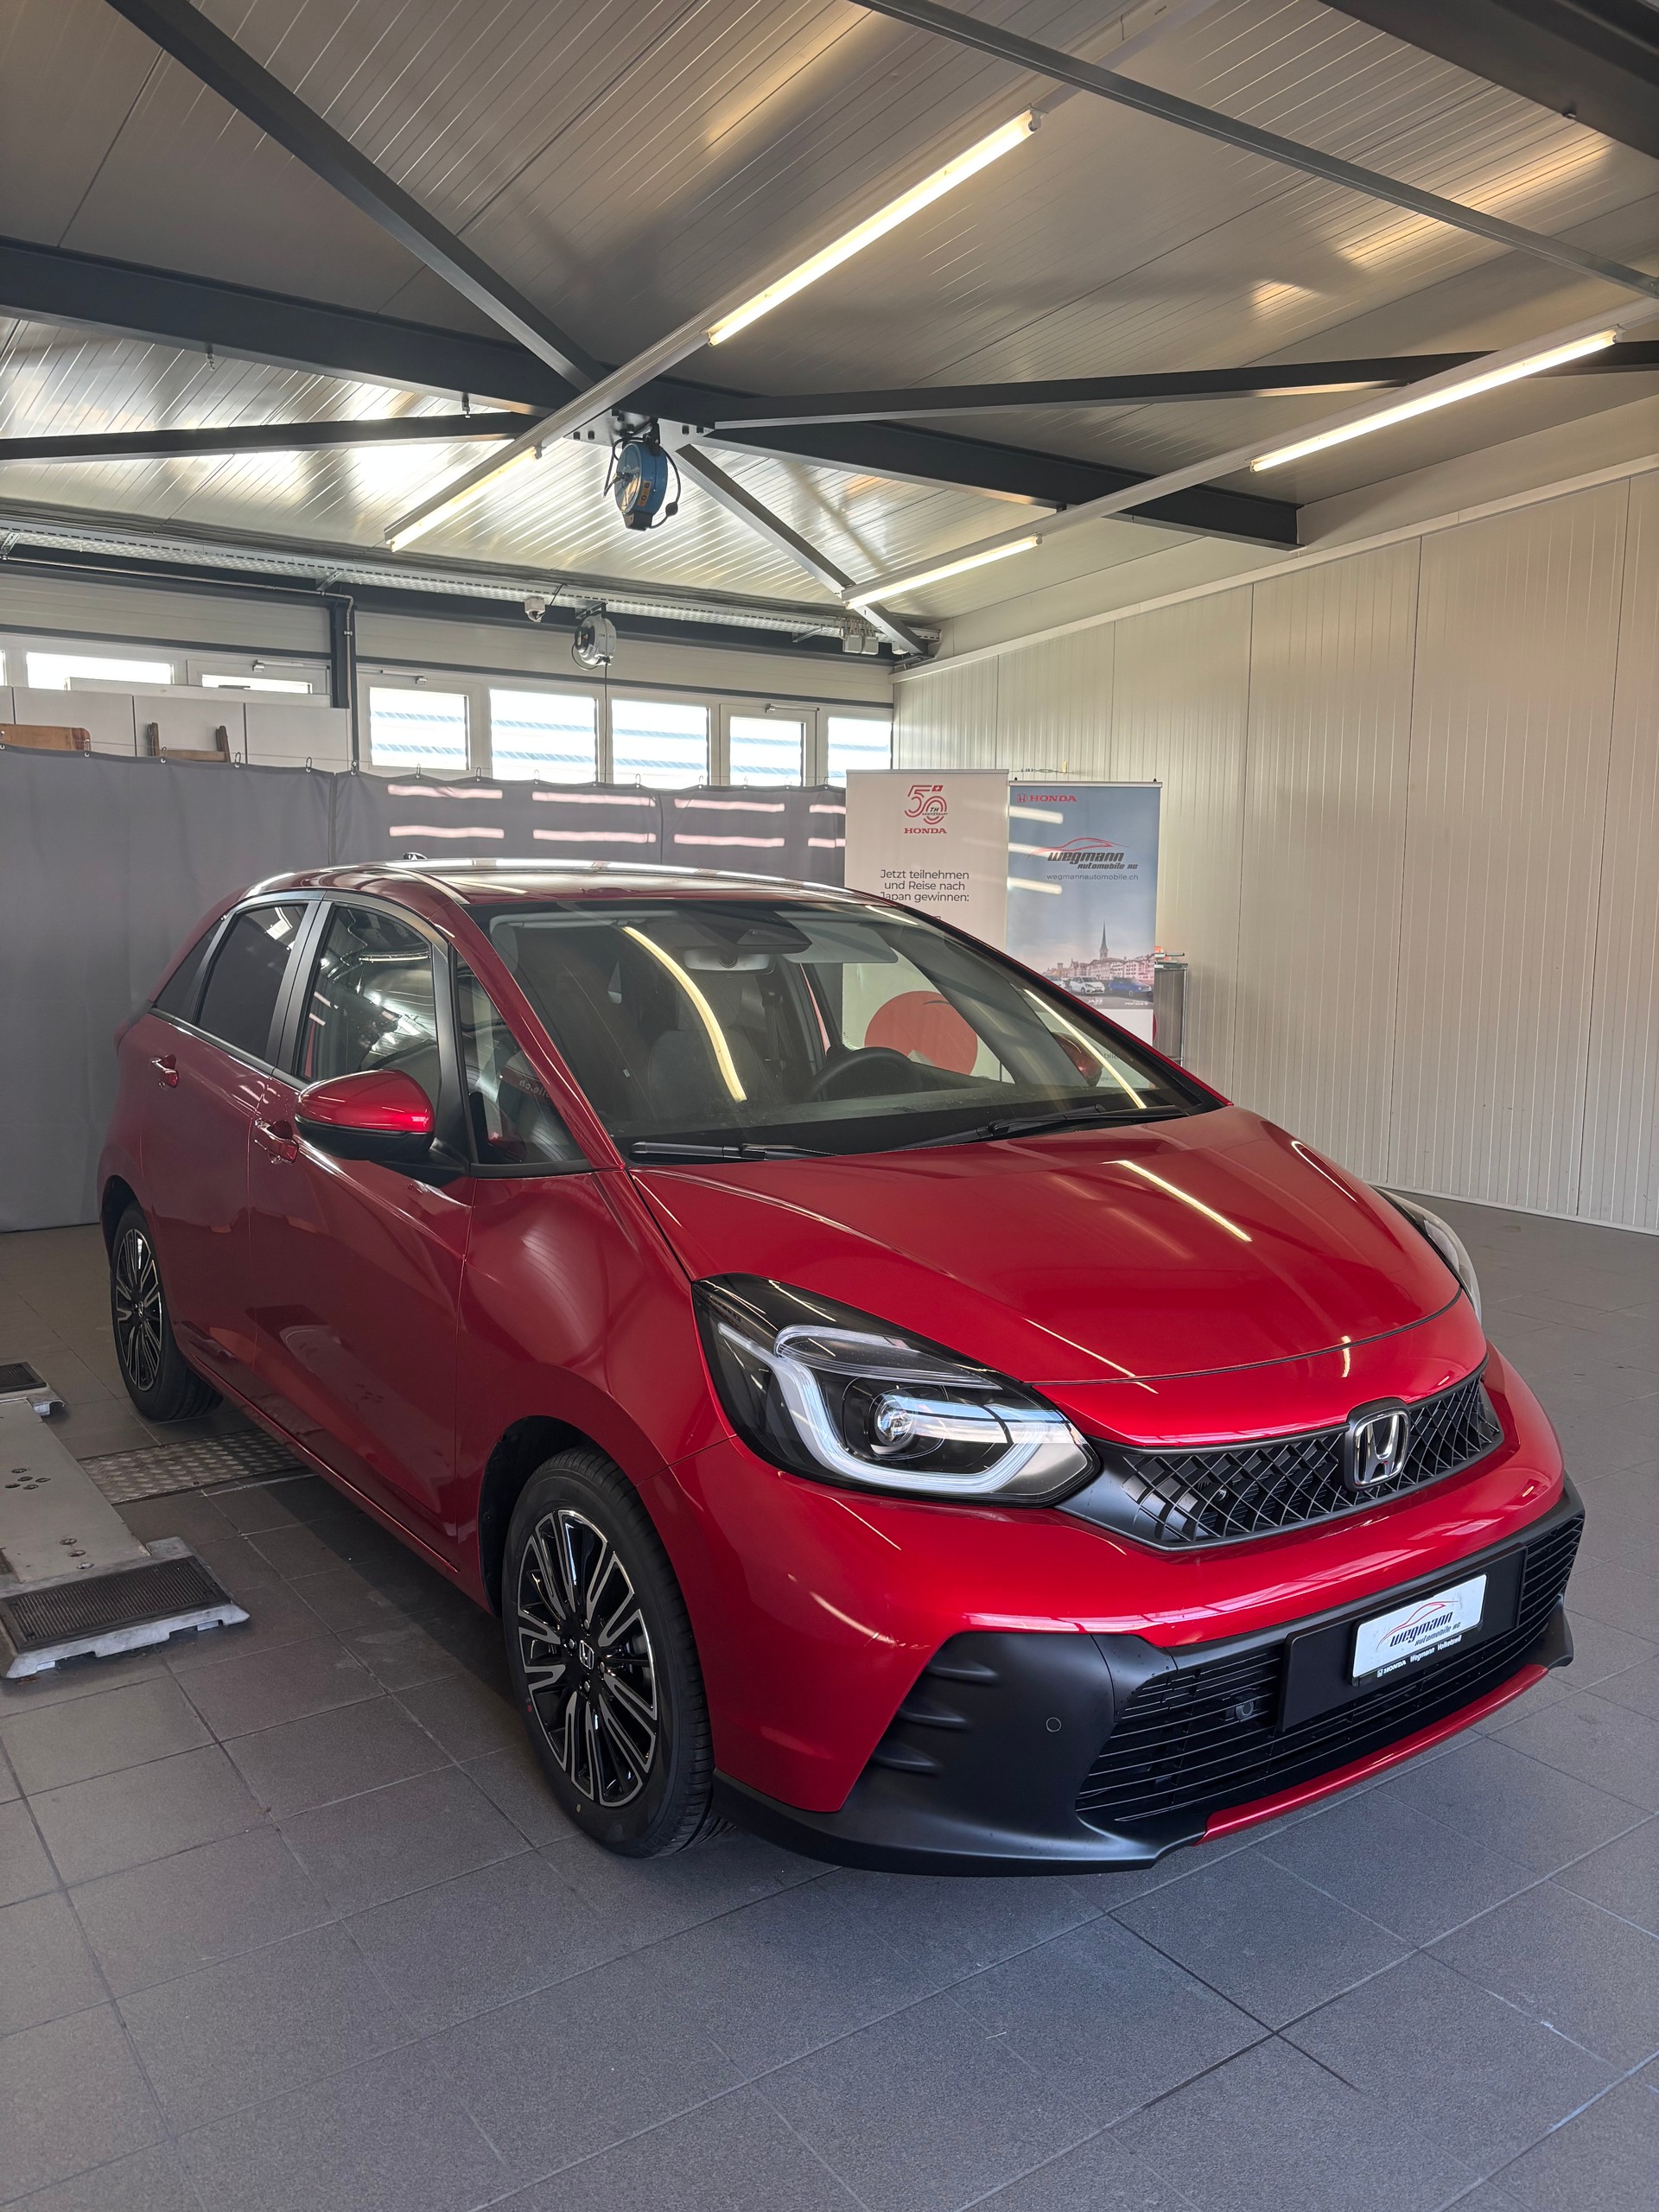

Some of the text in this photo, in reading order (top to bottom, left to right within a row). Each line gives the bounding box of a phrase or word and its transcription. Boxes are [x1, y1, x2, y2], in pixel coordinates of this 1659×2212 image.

[1047, 852, 1125, 864] wegmann
[880, 869, 969, 880] Jetzt teilnehmen
[884, 880, 966, 891] und Reise nach
[880, 892, 969, 903] Japan gewinnen:
[1389, 1611, 1453, 1648] wegmann
[1383, 1660, 1407, 1675] HONDA
[1410, 1647, 1435, 1663] Wegmann
